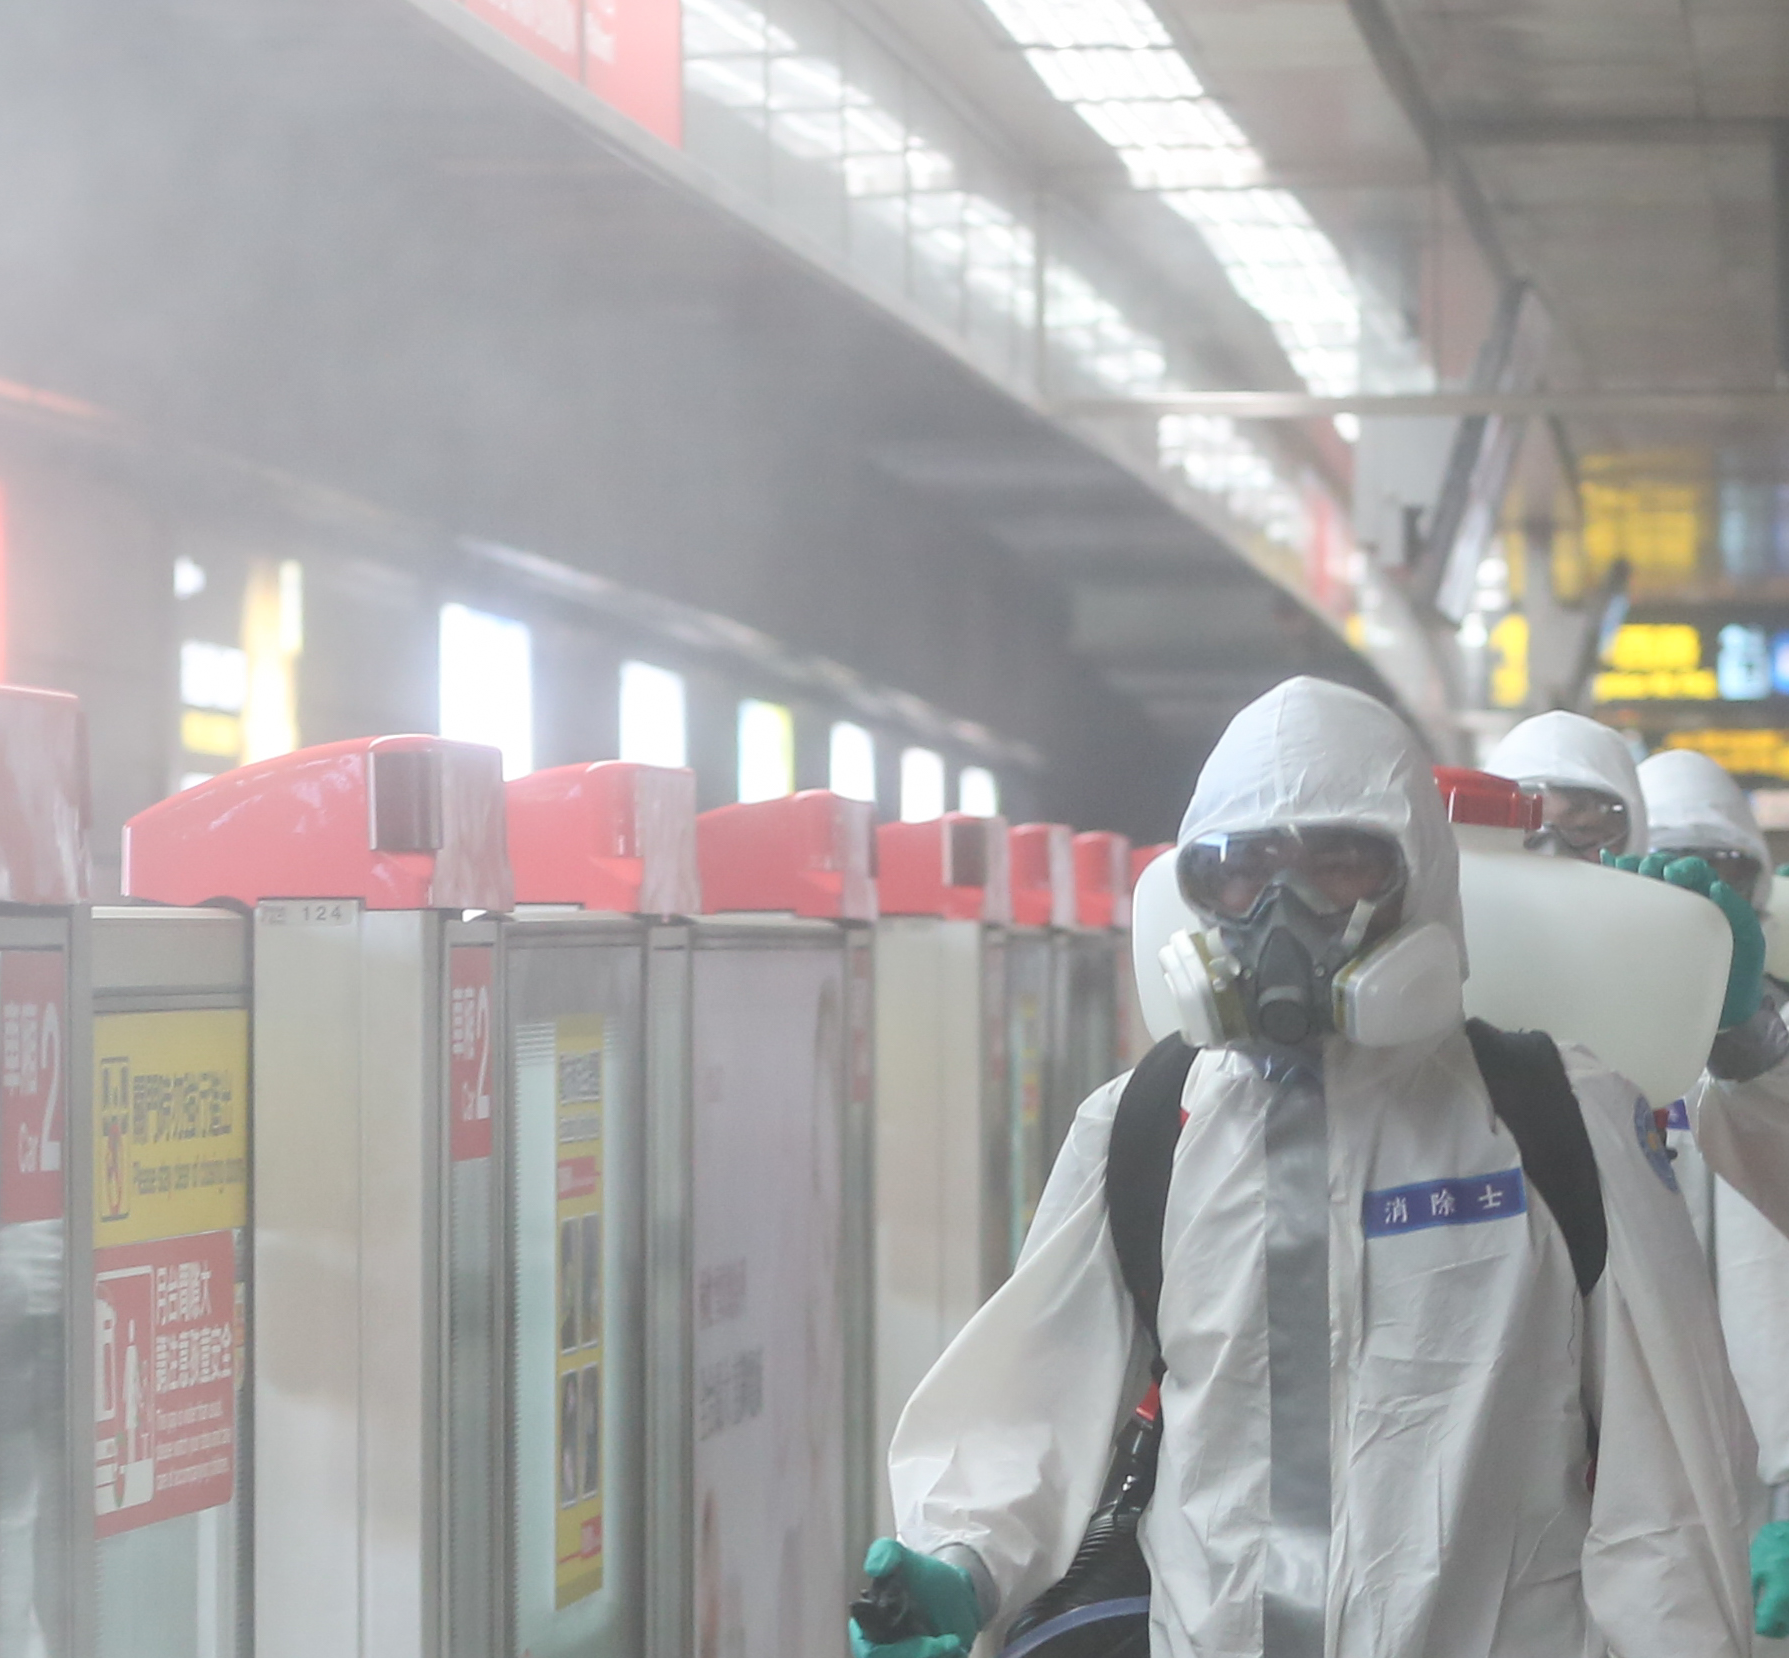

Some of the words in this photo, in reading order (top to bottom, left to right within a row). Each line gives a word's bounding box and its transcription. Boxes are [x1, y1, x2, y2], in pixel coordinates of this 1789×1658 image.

[40, 1001, 61, 1172] 2
[476, 985, 491, 1120] 2
[17, 1120, 39, 1175] Car
[1384, 1183, 1503, 1224] 消除士
